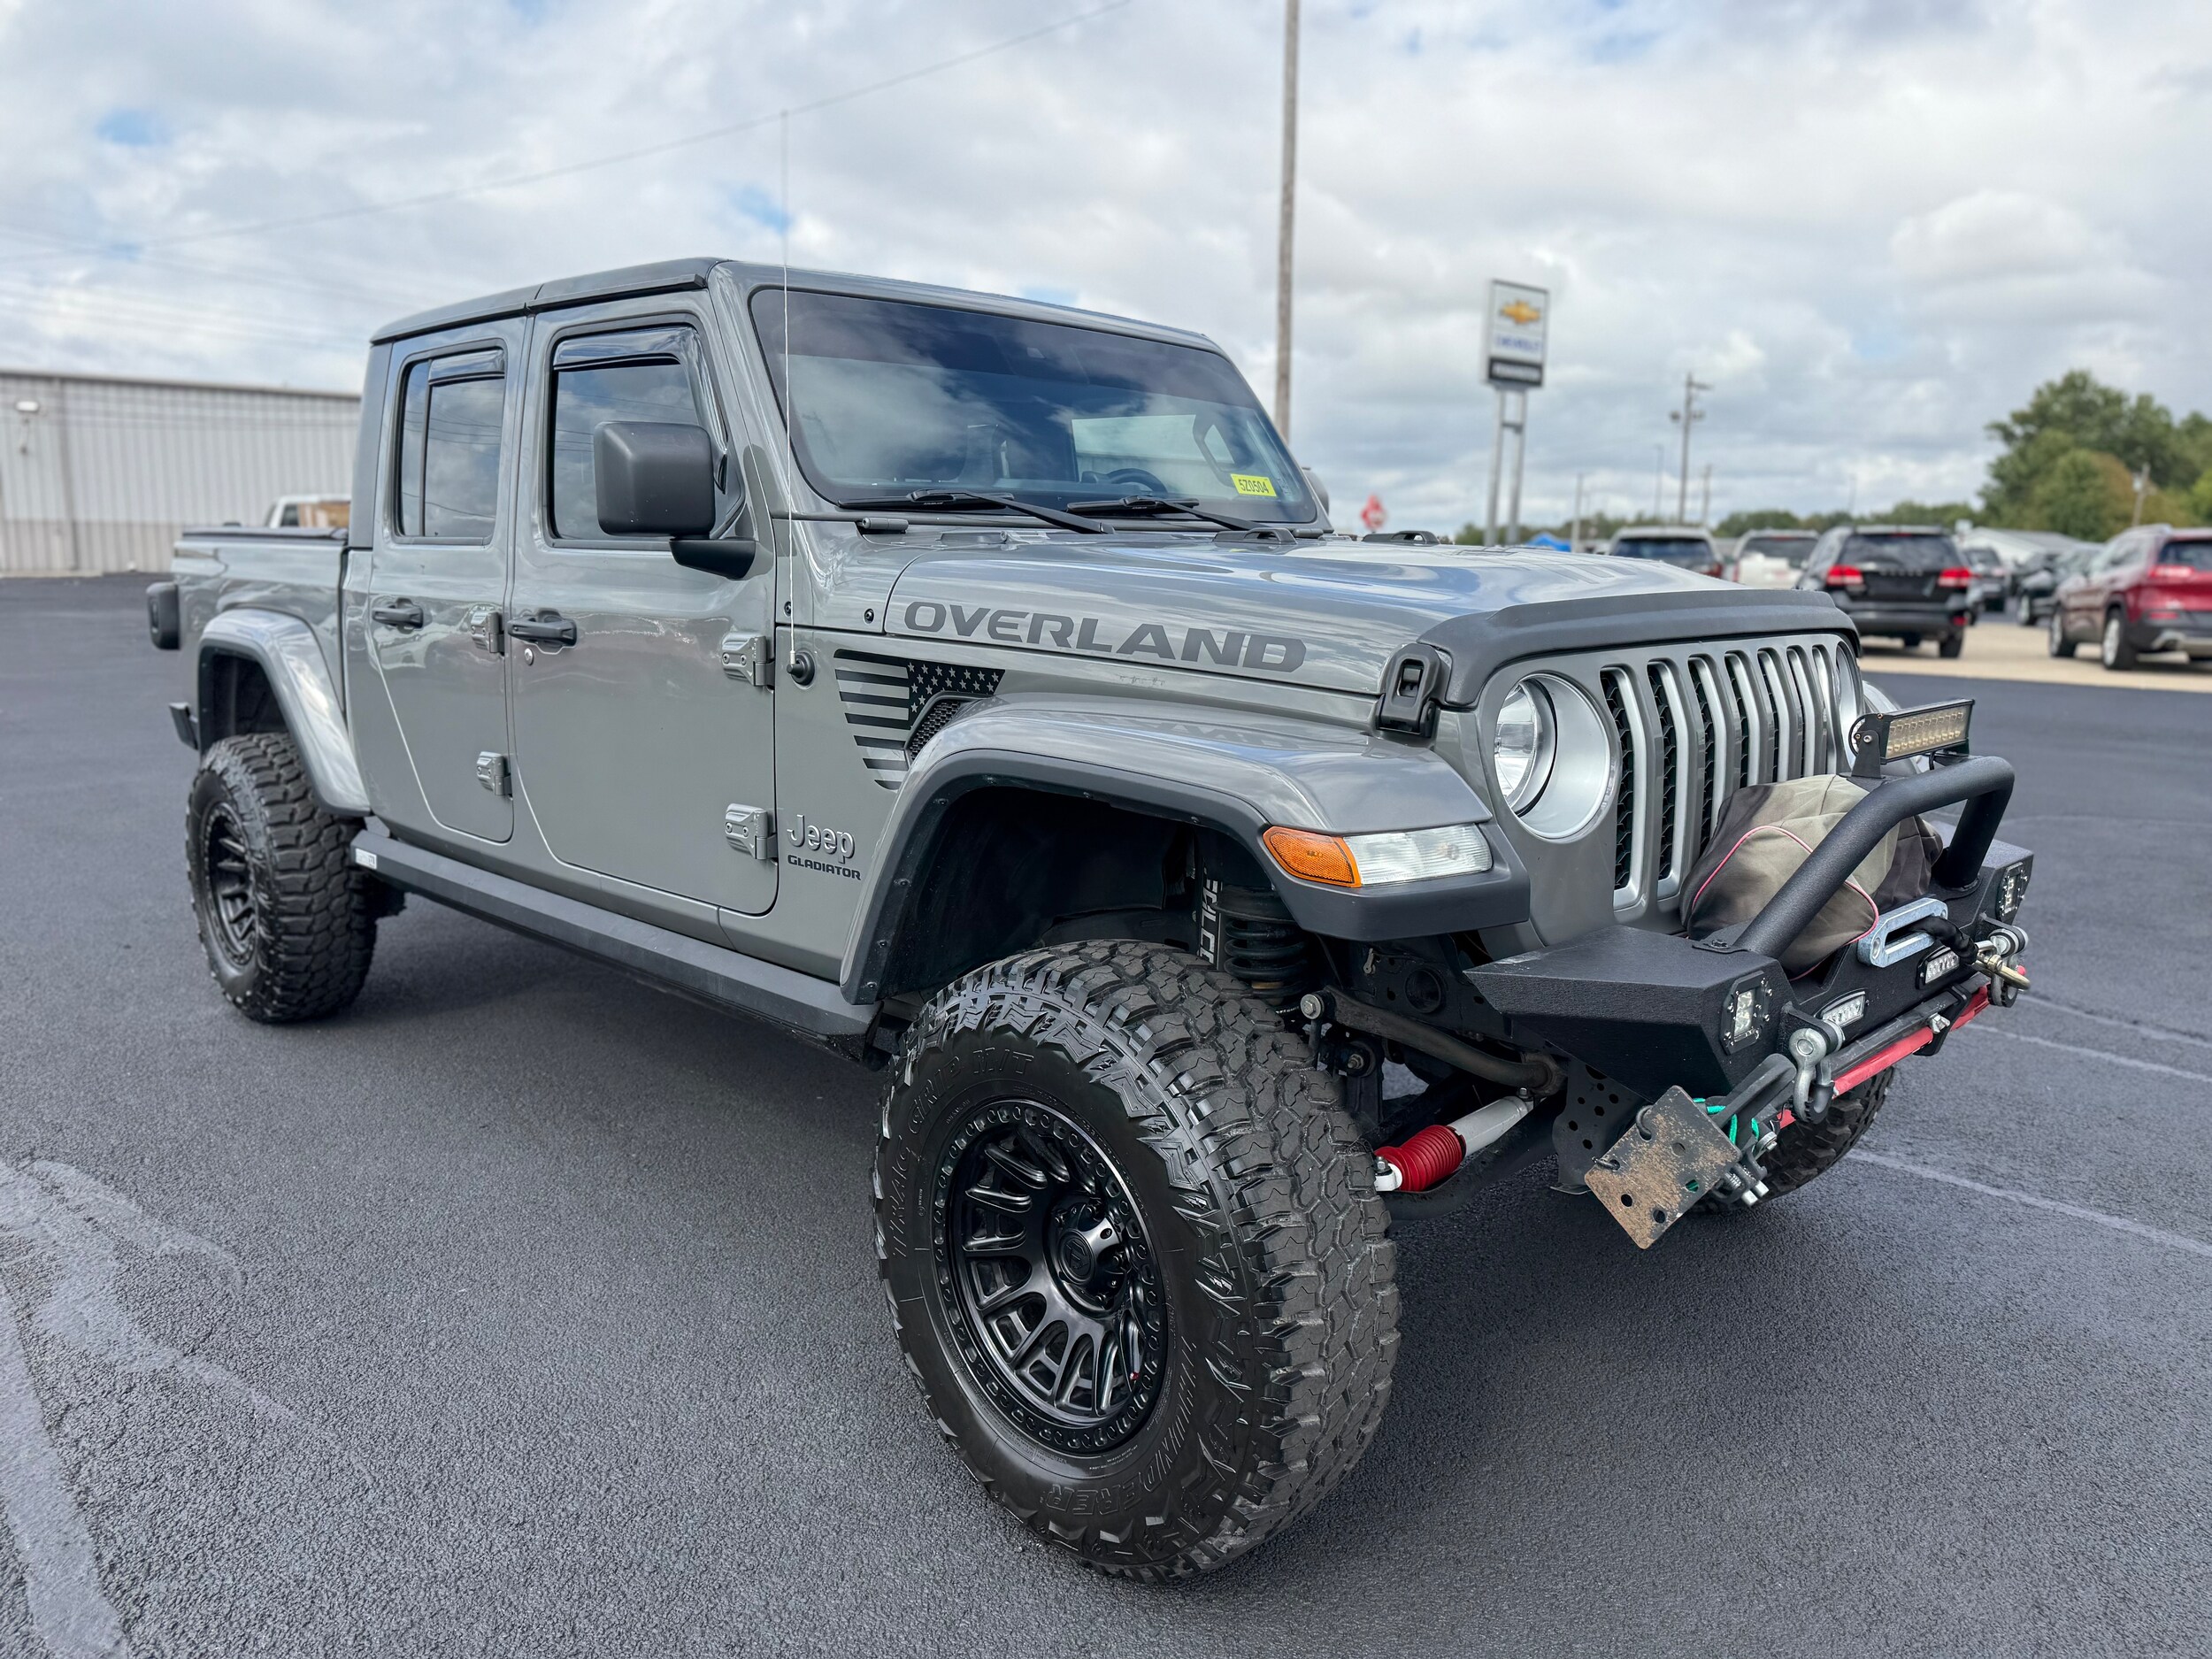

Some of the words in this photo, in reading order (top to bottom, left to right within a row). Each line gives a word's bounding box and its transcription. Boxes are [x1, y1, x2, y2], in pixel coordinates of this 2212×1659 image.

[1238, 479, 1270, 494] 5Z0504
[904, 601, 1307, 673] OVERLAND
[787, 814, 856, 864] Jeep
[787, 855, 861, 881] GLADIATOR
[908, 1056, 960, 1134] GRIP
[1045, 1335, 1196, 1516] THUNDERER
